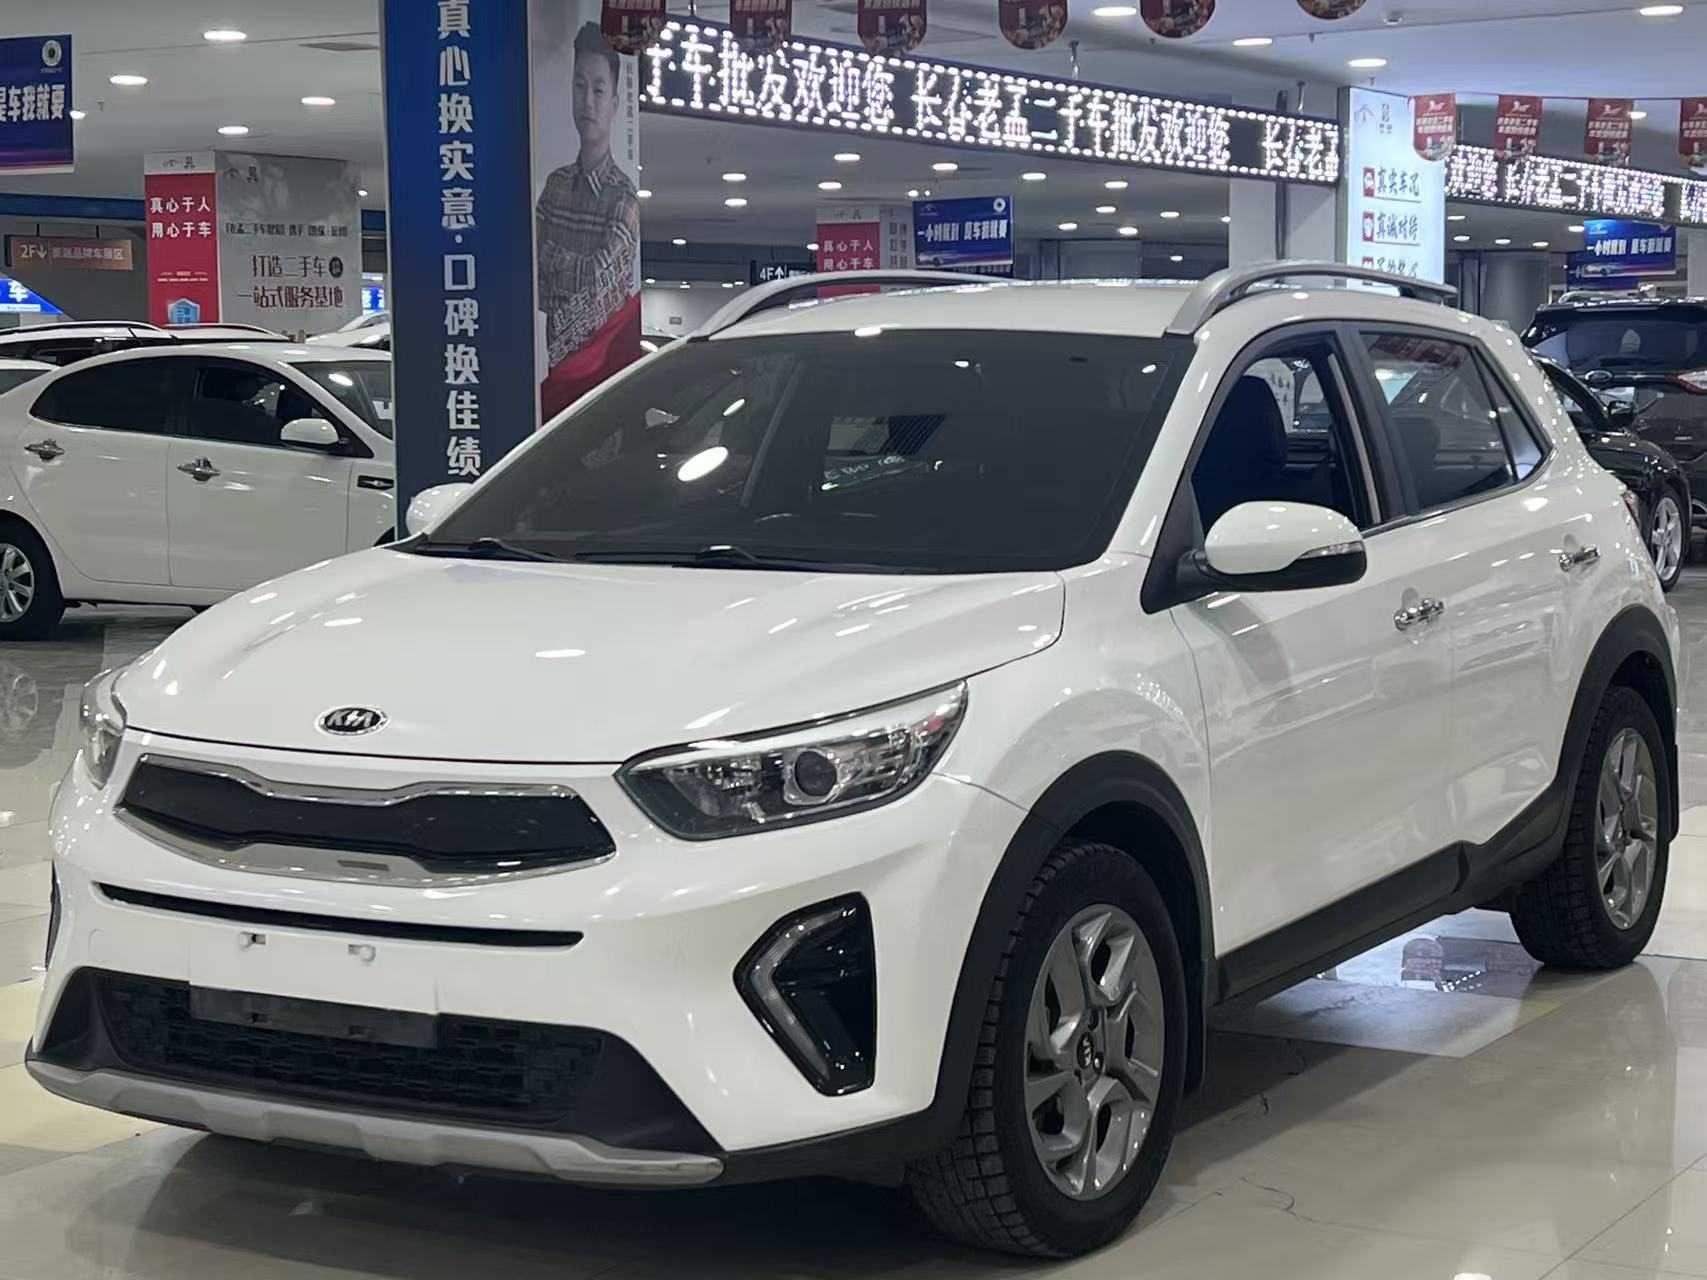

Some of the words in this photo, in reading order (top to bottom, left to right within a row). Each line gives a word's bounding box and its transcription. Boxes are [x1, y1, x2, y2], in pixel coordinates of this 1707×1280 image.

[150, 197, 211, 213] 真心于人
[151, 222, 212, 238] 用心于车
[20, 245, 36, 258] 2F
[252, 256, 326, 277] 打造二手车
[760, 267, 775, 281] 4F
[238, 286, 343, 308] 一站式服务基地
[327, 709, 373, 728] KIA
